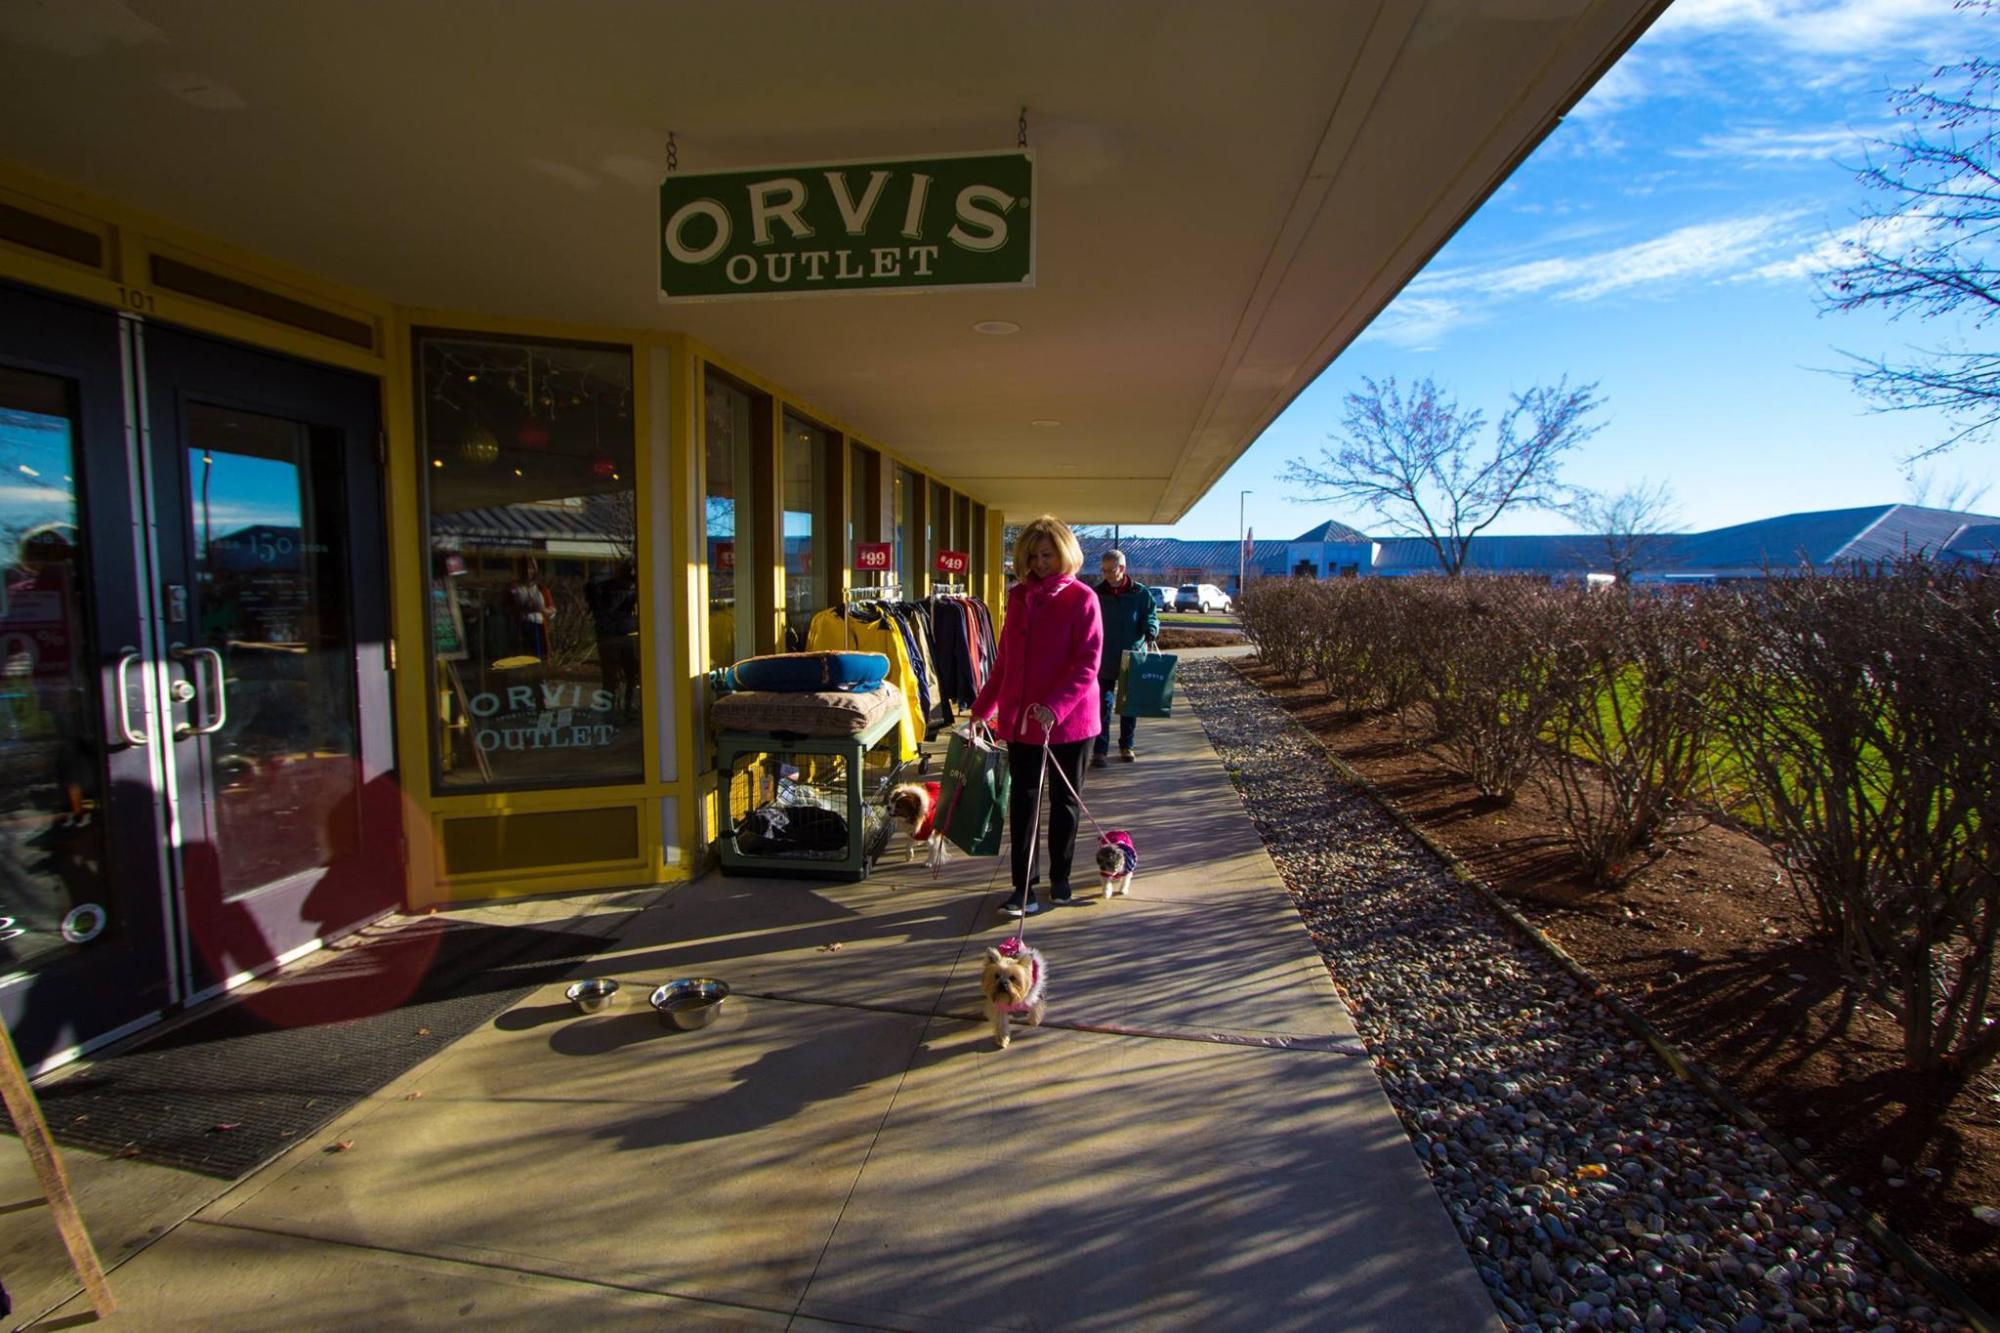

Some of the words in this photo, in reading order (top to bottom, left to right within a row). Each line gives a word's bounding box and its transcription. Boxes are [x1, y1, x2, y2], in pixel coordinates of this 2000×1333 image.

[665, 170, 1017, 265] ORVIS
[726, 245, 939, 285] OUTLET
[119, 287, 155, 312] 101
[249, 532, 293, 563] 150
[470, 684, 614, 717] ORVIS
[475, 724, 614, 752] OUTLET
